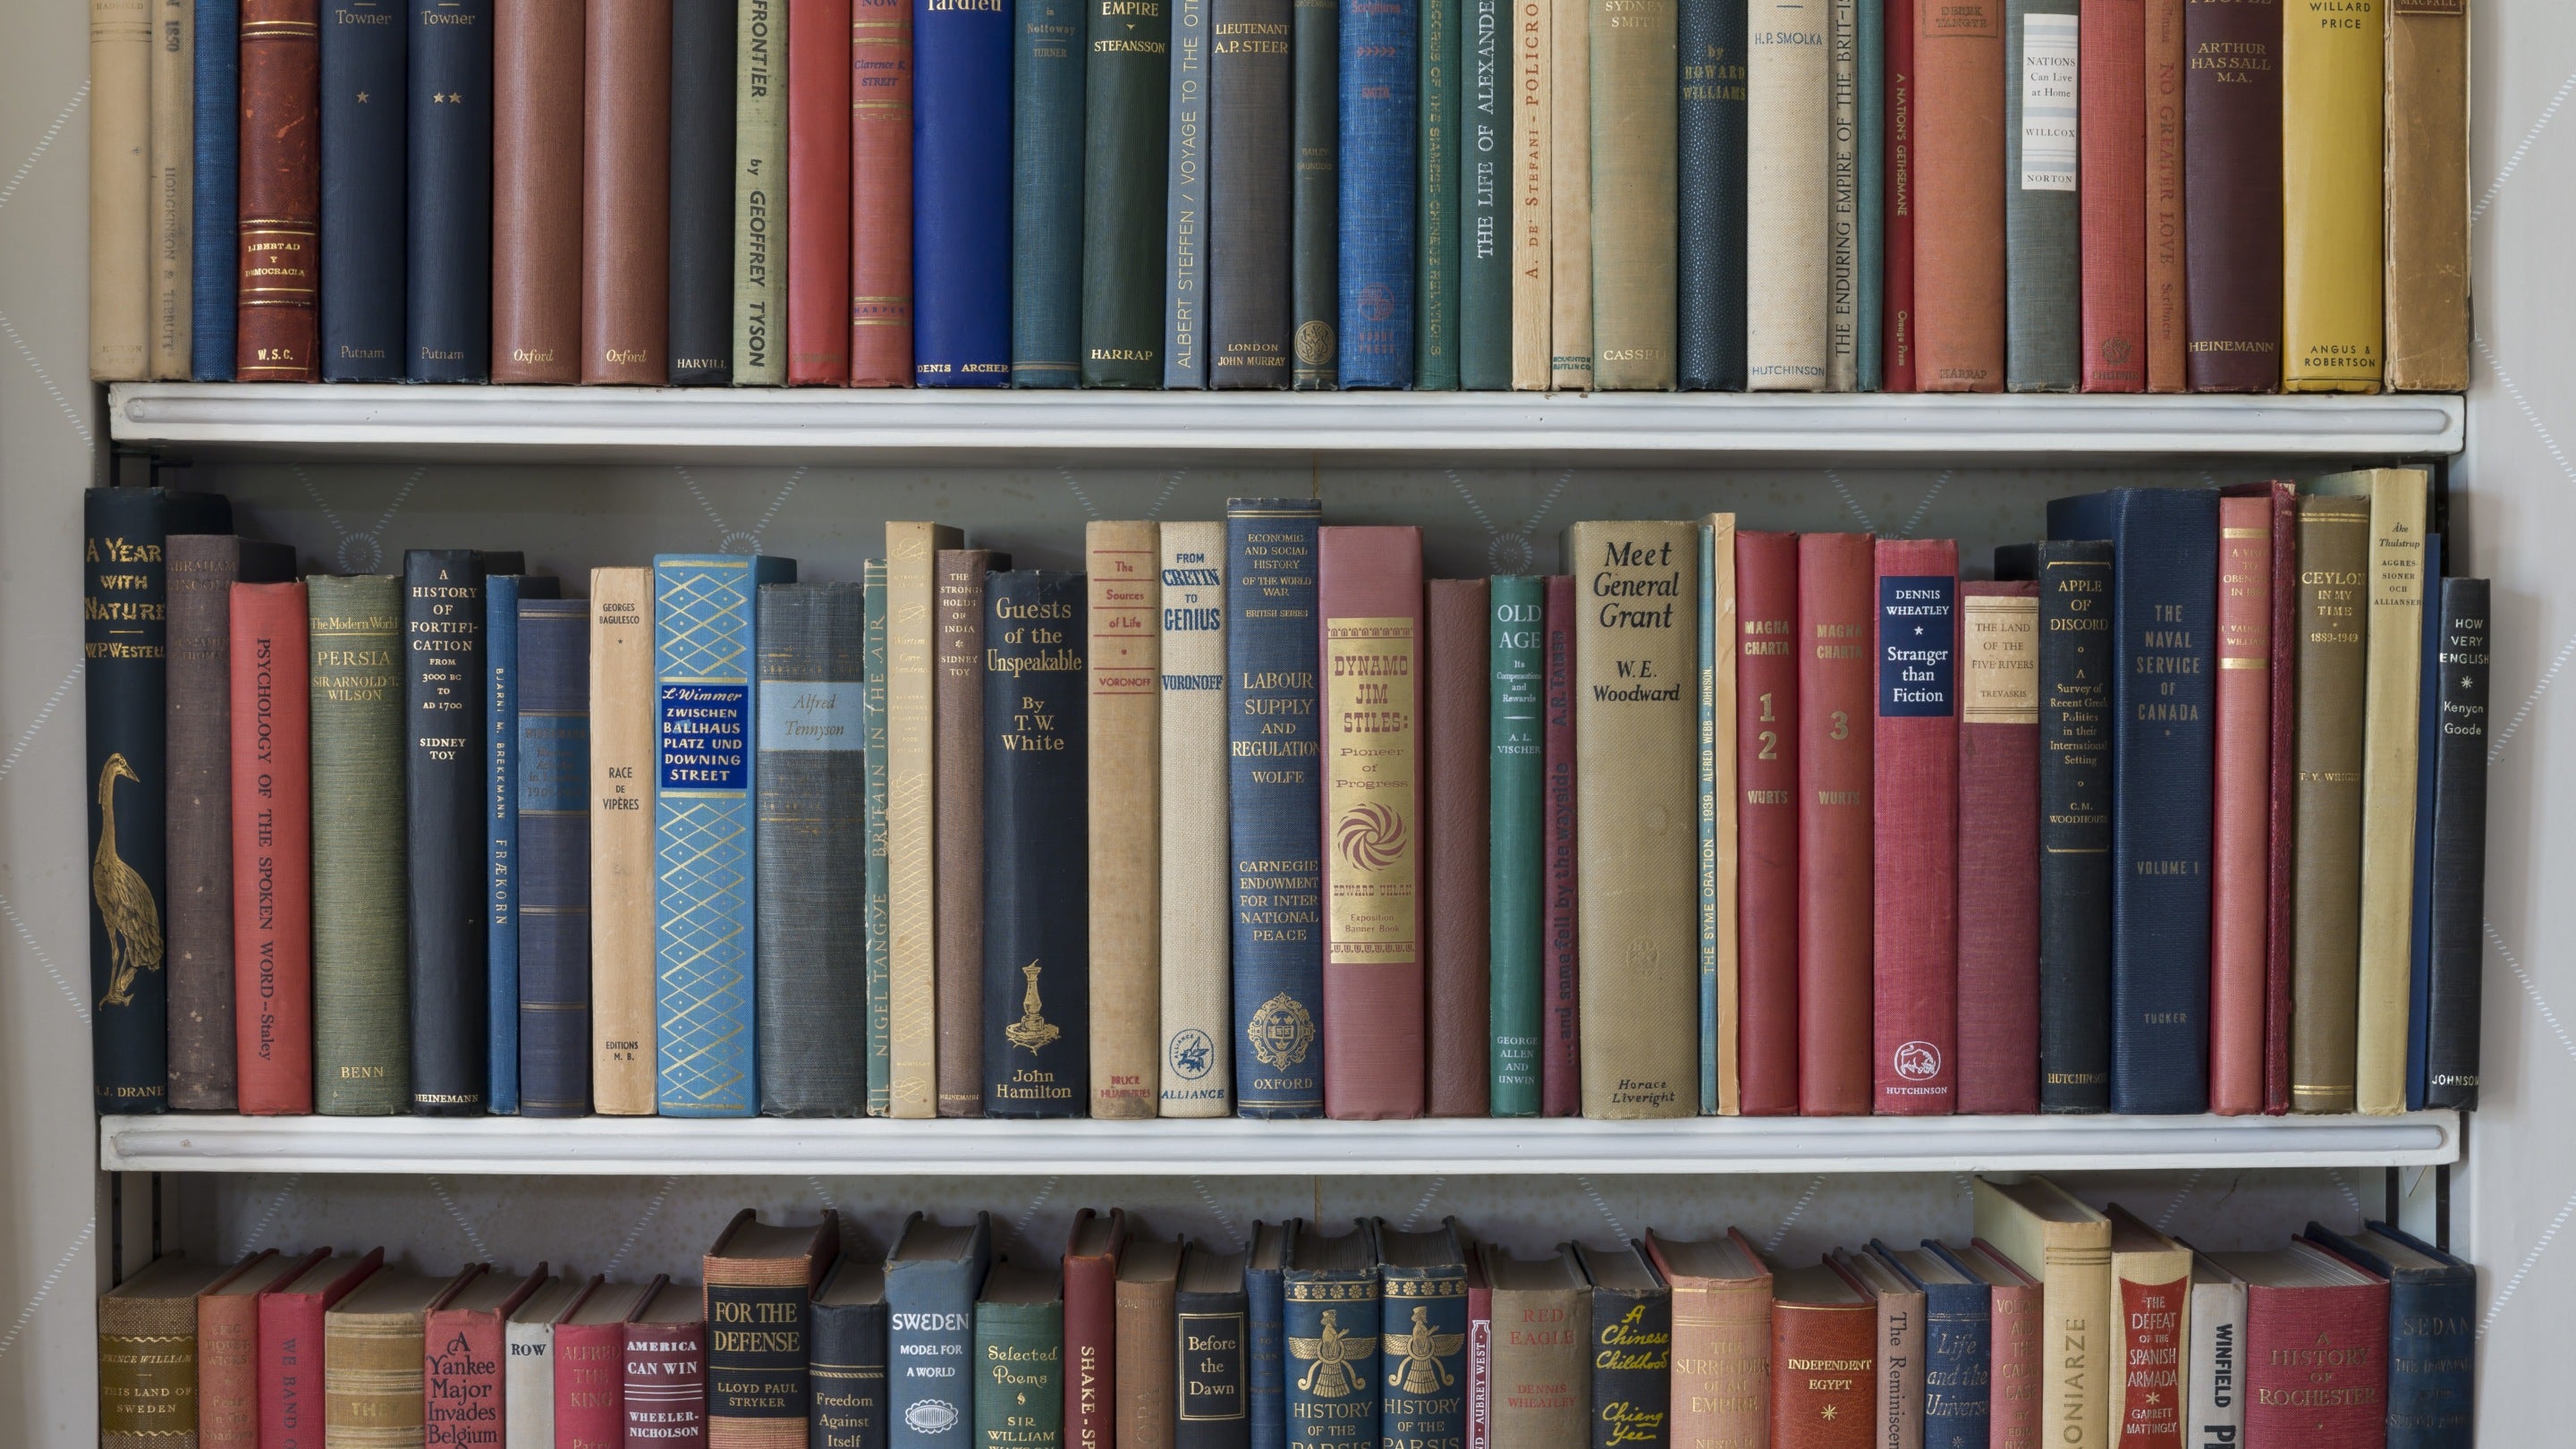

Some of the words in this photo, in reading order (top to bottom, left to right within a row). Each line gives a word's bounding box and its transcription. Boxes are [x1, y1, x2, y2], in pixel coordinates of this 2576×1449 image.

[2309, 3, 2370, 13] WILLARD
[336, 10, 392, 24] Towner
[422, 11, 475, 25] Towner
[1216, 23, 1289, 35] LIEUTENANT
[2321, 19, 2360, 29] PRICE
[1095, 41, 1165, 54] STEFANSSON
[1215, 42, 1239, 54] A.P.
[1243, 42, 1288, 54] STEER
[2199, 43, 2266, 54] ARTHUR
[1183, 37, 1198, 72] THE
[2027, 56, 2076, 66] NATIONS
[2191, 58, 2270, 69] HASSALL
[2031, 73, 2048, 81] Can
[2054, 73, 2072, 81] Live
[1182, 80, 1196, 103] TO
[1837, 72, 1852, 111] THE
[2046, 89, 2071, 97] Home
[1837, 117, 1852, 142] OF
[2026, 129, 2075, 137] WILLCOX
[1479, 124, 1494, 151] OF
[1182, 111, 1196, 184] VOYAGE
[747, 158, 762, 176] by
[1479, 162, 1494, 202] LIFE
[1836, 150, 1852, 213] EMPIRE
[2027, 174, 2072, 182] NORTON
[750, 190, 766, 287] GEOFFREY
[1478, 216, 1494, 258] THE
[1179, 210, 1194, 291] STEFFEN
[1836, 222, 1850, 318] ENDURING
[750, 302, 766, 368] TYSON
[1177, 298, 1191, 368] ALBERT
[1836, 324, 1850, 357] THE
[2189, 341, 2274, 352] HEINEMANN
[342, 345, 385, 359] Putnam
[422, 346, 463, 360] Putnam
[1091, 350, 1152, 360] HARRAP
[2311, 345, 2356, 354] ANGUS
[2364, 345, 2370, 353] &
[513, 349, 554, 364] Oxford
[1218, 356, 1243, 366] JOHN
[1246, 356, 1285, 366] MURRAY
[2305, 358, 2376, 367] ROBERTSON
[1752, 365, 1825, 377] HUTCHINSON
[1176, 554, 1204, 564] FROM
[1604, 542, 1672, 566] Meet
[439, 570, 448, 580] A
[1594, 572, 1679, 597] General
[412, 587, 478, 597] HISTORY
[1185, 594, 1198, 603] TO
[1896, 590, 1940, 599] DENNIS
[433, 605, 453, 615] OF
[603, 603, 635, 612] GEORGES
[996, 597, 1072, 618] Guests
[1498, 605, 1541, 622] OLD
[1886, 606, 1949, 615] WHEATLEY
[1165, 608, 1220, 631] GENIUS
[1600, 604, 1673, 628] Grant
[411, 622, 479, 632] FORTIFI-
[1976, 623, 1996, 631] THE
[2002, 623, 2030, 631] LAND
[2455, 619, 2483, 628] HOW
[1004, 628, 1024, 644] of
[1031, 629, 1061, 643] the
[1499, 631, 1540, 648] AGE
[2451, 637, 2483, 646] VERY
[413, 640, 472, 651] CATION
[1984, 641, 1998, 650] OF
[2003, 641, 2023, 650] THE
[318, 652, 393, 665] PERSIA
[1888, 647, 1948, 665] Stranger
[2440, 654, 2489, 664] ENGLISH
[987, 649, 1081, 677] Unspeakable
[1335, 656, 1408, 675] DYNAMO
[1972, 660, 1996, 669] FIVE
[1999, 660, 2034, 669] RIVERS
[1902, 667, 1935, 681] than
[1243, 674, 1312, 689] LABOUR
[1356, 684, 1387, 704] JIM
[1594, 684, 1681, 702] Woodward
[1894, 689, 1943, 702] Fiction
[258, 639, 271, 764] PSYCHOLOGY
[1022, 697, 1044, 713] By
[1245, 699, 1314, 715] SUPPLY
[1760, 693, 1775, 722] 1
[667, 708, 737, 717] ZWISCHEN
[2445, 702, 2483, 716] Kenyon
[1261, 724, 1296, 733] AND
[1830, 711, 1848, 740] 3
[2445, 724, 2482, 735] Goode
[419, 738, 466, 748] SIDNEY
[664, 739, 705, 749] PLATZ
[712, 739, 742, 749] UND
[1002, 734, 1064, 750] White
[1758, 731, 1776, 759] 2
[429, 750, 455, 759] TOY
[1498, 745, 1540, 754] VISCHER
[665, 755, 741, 765] DOWNING
[608, 767, 632, 778] RACE
[671, 770, 730, 780] STREET
[1252, 771, 1304, 784] WOLFE
[496, 742, 505, 818] BREKKMANN
[1336, 780, 1408, 789] Progress
[258, 775, 272, 799] OF
[603, 798, 639, 810] VIPÈRES
[258, 809, 272, 847] THE
[1240, 860, 1318, 871] CARNEGIE
[496, 840, 507, 924] FRÆKORN
[259, 858, 272, 930] SPOKEN
[1253, 930, 1307, 940] PEACE
[341, 1067, 383, 1078] BENN
[1013, 1070, 1054, 1082] John
[1254, 1080, 1313, 1089] OXFORD
[1620, 1080, 1666, 1089] Horace
[1886, 1087, 1947, 1095] HUTCHINSON
[996, 1085, 1072, 1099] Hamilton
[1162, 1089, 1224, 1098] ALLIANCE
[1612, 1092, 1674, 1107] Liveright
[716, 1302, 753, 1324] FOR
[755, 1303, 797, 1323] THE
[893, 1313, 969, 1331] SWEDEN
[2131, 1313, 2176, 1328] DEFEAT
[447, 1332, 470, 1354] A
[714, 1332, 800, 1352] DEFENSE
[1189, 1336, 1235, 1351] Before
[2140, 1335, 2152, 1343] OF
[2155, 1335, 2169, 1343] THE
[512, 1344, 547, 1355] ROW
[627, 1342, 697, 1351] AMERICA
[901, 1345, 938, 1354] MODEL
[942, 1345, 963, 1354] FOR
[987, 1346, 1057, 1360] Selected
[2130, 1349, 2176, 1365] SPANISH
[427, 1355, 496, 1375] Yankee
[628, 1362, 659, 1374] CAN
[665, 1361, 697, 1374] WIN
[1201, 1359, 1224, 1373] the
[1789, 1360, 1871, 1370] INDEPENDENT
[2214, 1325, 2233, 1407] WINFIELD
[907, 1368, 914, 1377] A
[916, 1368, 954, 1377] WORLD
[993, 1366, 1047, 1387] Poems
[2128, 1371, 2177, 1386] ARMADA
[432, 1379, 492, 1405] Major
[1191, 1383, 1234, 1395] Dawn
[1809, 1380, 1852, 1391] EGYPT
[428, 1402, 496, 1421] Invades
[1294, 1402, 1373, 1418] HISTORY
[2131, 1409, 2173, 1419] GARRETT
[1007, 1418, 1036, 1426] SIR
[2127, 1422, 2176, 1434] MATTINGLY
[630, 1428, 699, 1437] NICHOLSON
[987, 1431, 1055, 1441] WILLIAM
[1308, 1427, 1325, 1436] OF
[1329, 1425, 1355, 1436] THE
